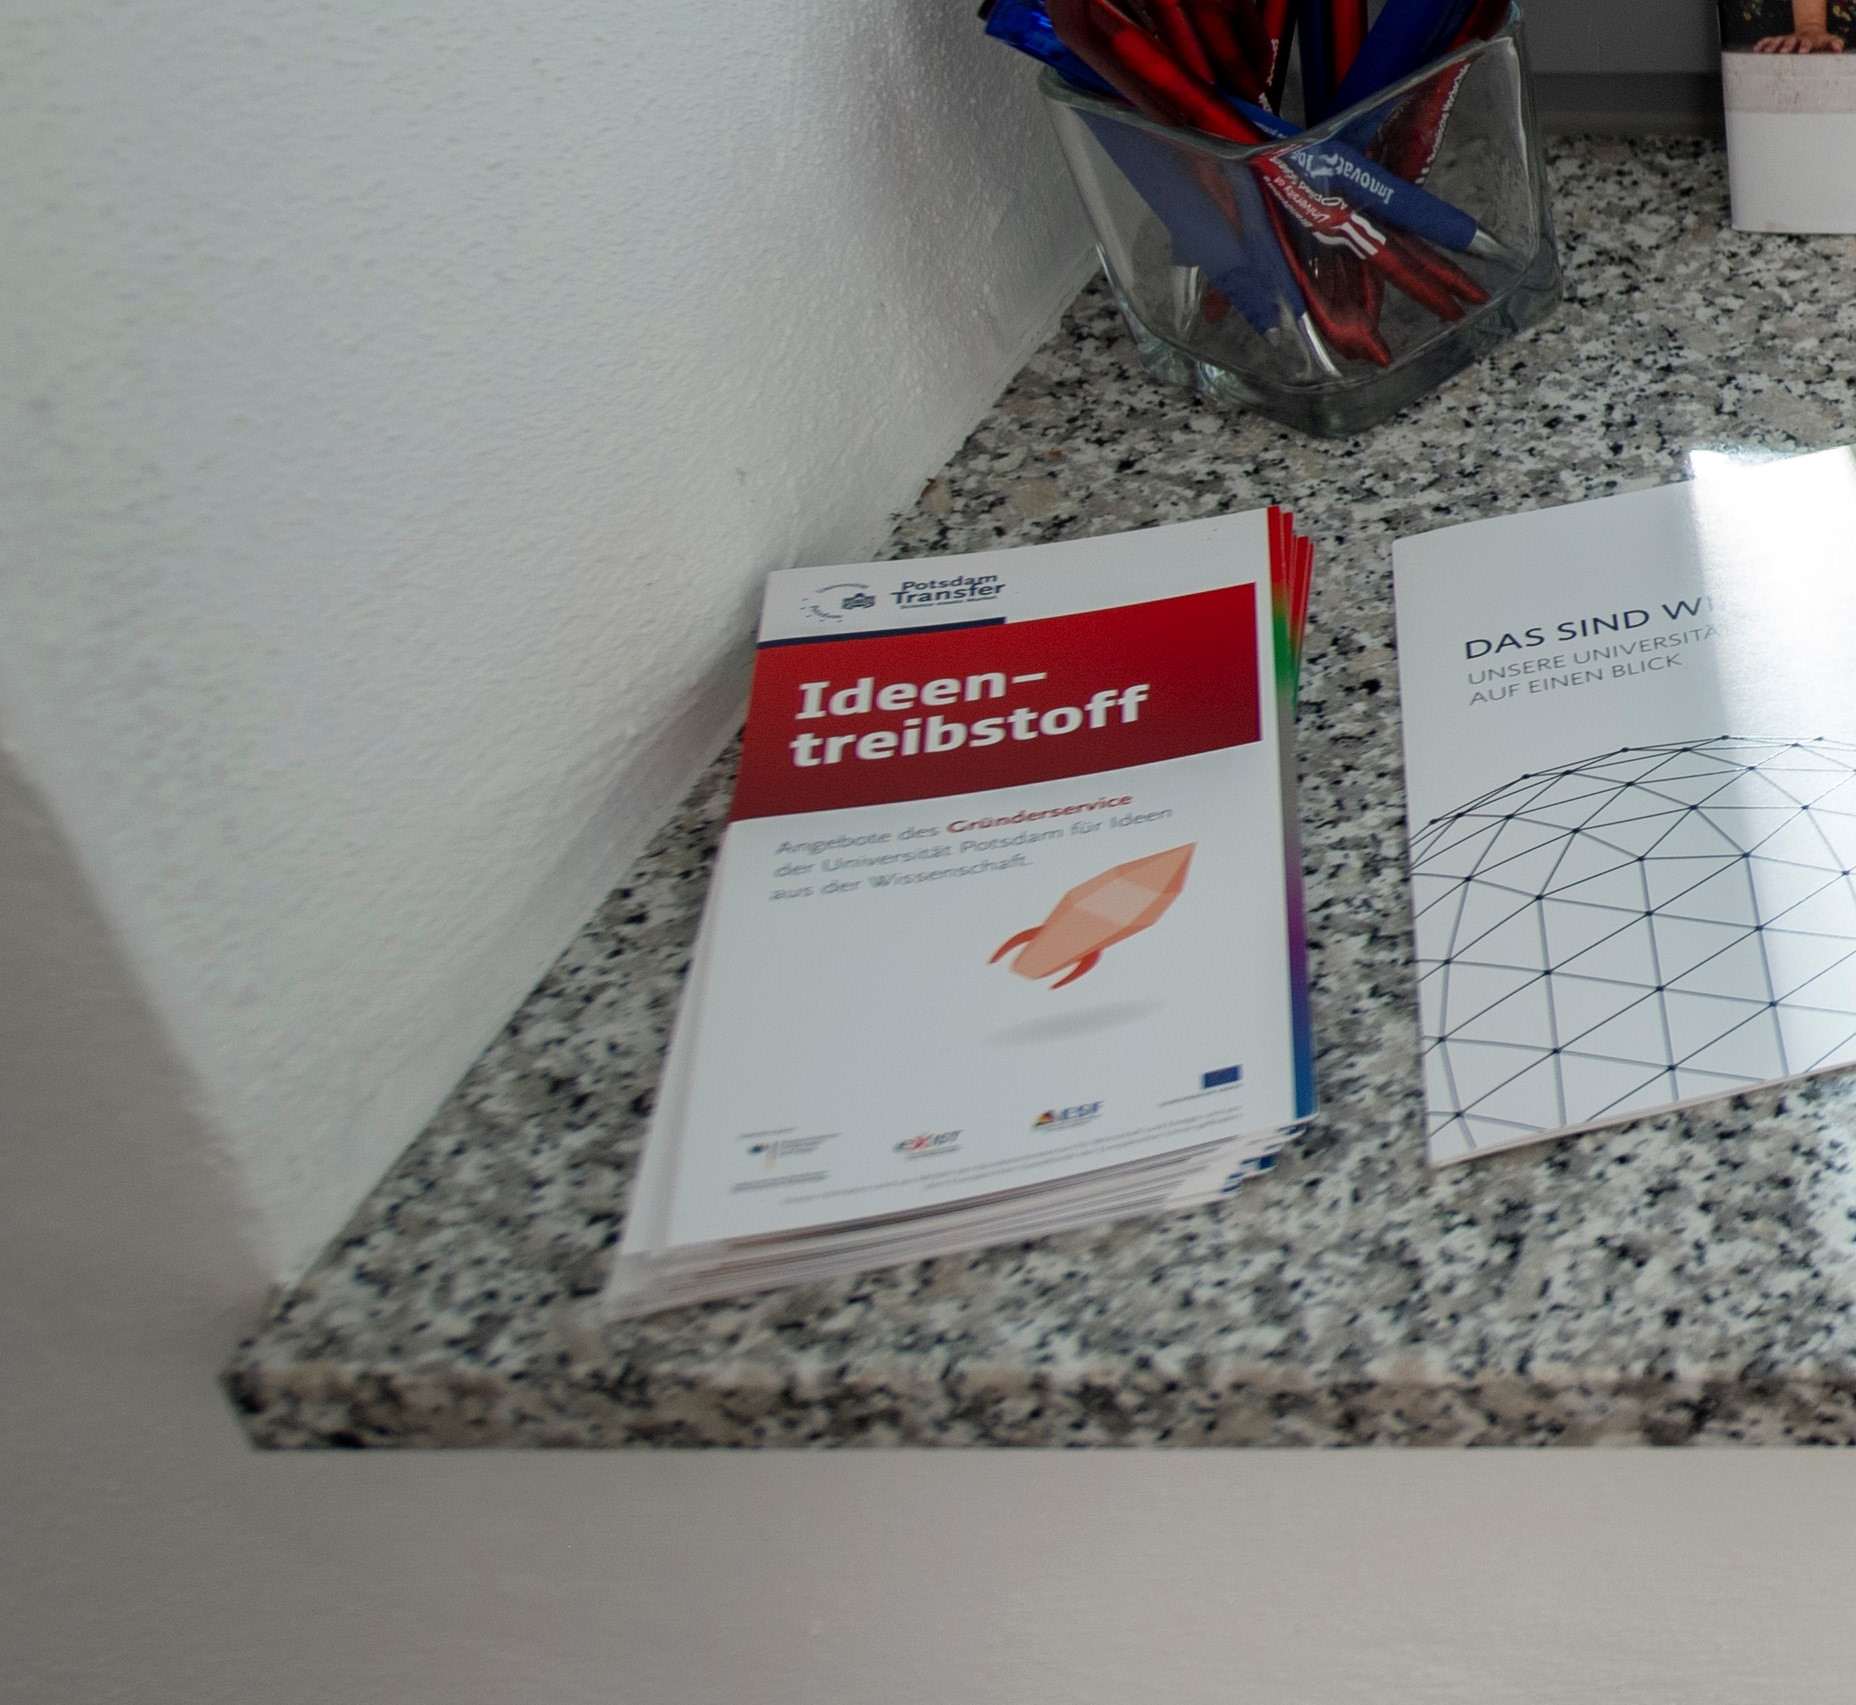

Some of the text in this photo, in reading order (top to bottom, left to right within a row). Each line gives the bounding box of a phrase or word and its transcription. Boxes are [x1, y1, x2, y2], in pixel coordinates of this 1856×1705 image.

[890, 583, 1006, 605] Transfer
[901, 575, 998, 591] Potsdam
[1464, 626, 1545, 660] DAS
[1557, 608, 1649, 642] SIND
[1468, 623, 1726, 685] UNSERE UNIVERSITÄ
[1469, 654, 1682, 706] AUF EINEN BLICK
[789, 685, 1150, 768] treibstoff
[773, 808, 1173, 878] der Universität Potsdam für Ideen
[775, 793, 1133, 856] Angebote des Gründerservice
[770, 887, 813, 900] aus
[821, 880, 862, 894] der
